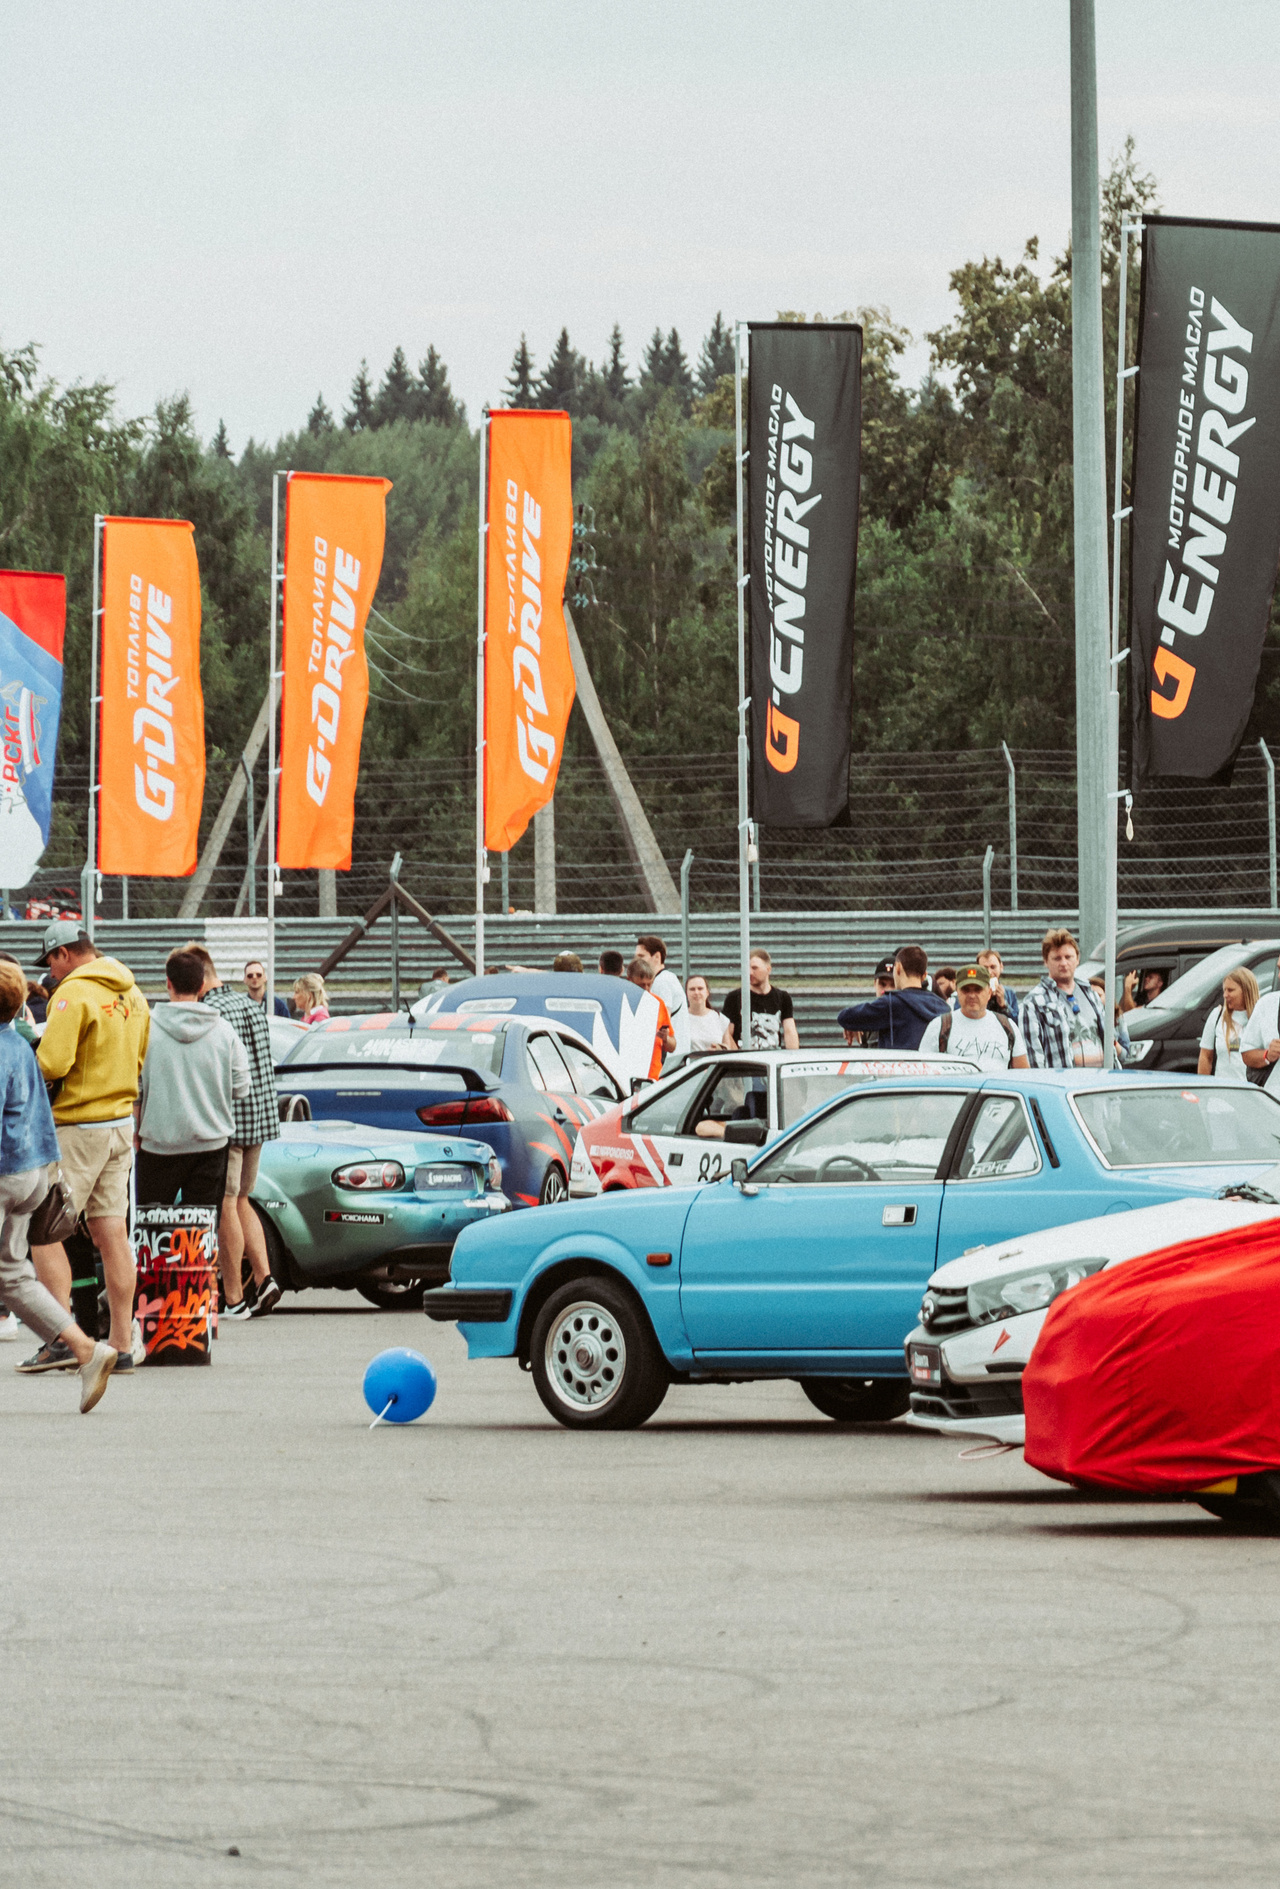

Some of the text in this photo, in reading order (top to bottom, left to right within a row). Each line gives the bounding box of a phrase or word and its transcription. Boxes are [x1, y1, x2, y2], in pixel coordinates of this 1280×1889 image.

[764, 383, 783, 614] МОТОРНОЕ МАСЛО
[1150, 295, 1258, 720] G-ENERGY
[1168, 285, 1206, 550] МОТОРНОЕ МАСЛО
[126, 573, 143, 699] ТОПЛИВО
[308, 535, 328, 674] ТОПЛИВО
[506, 478, 519, 635] ТОПЛИВО
[132, 583, 181, 822] G-DRIVE
[306, 546, 361, 807] G-DRIVE
[341, 1213, 381, 1223] YOKOHAMA
